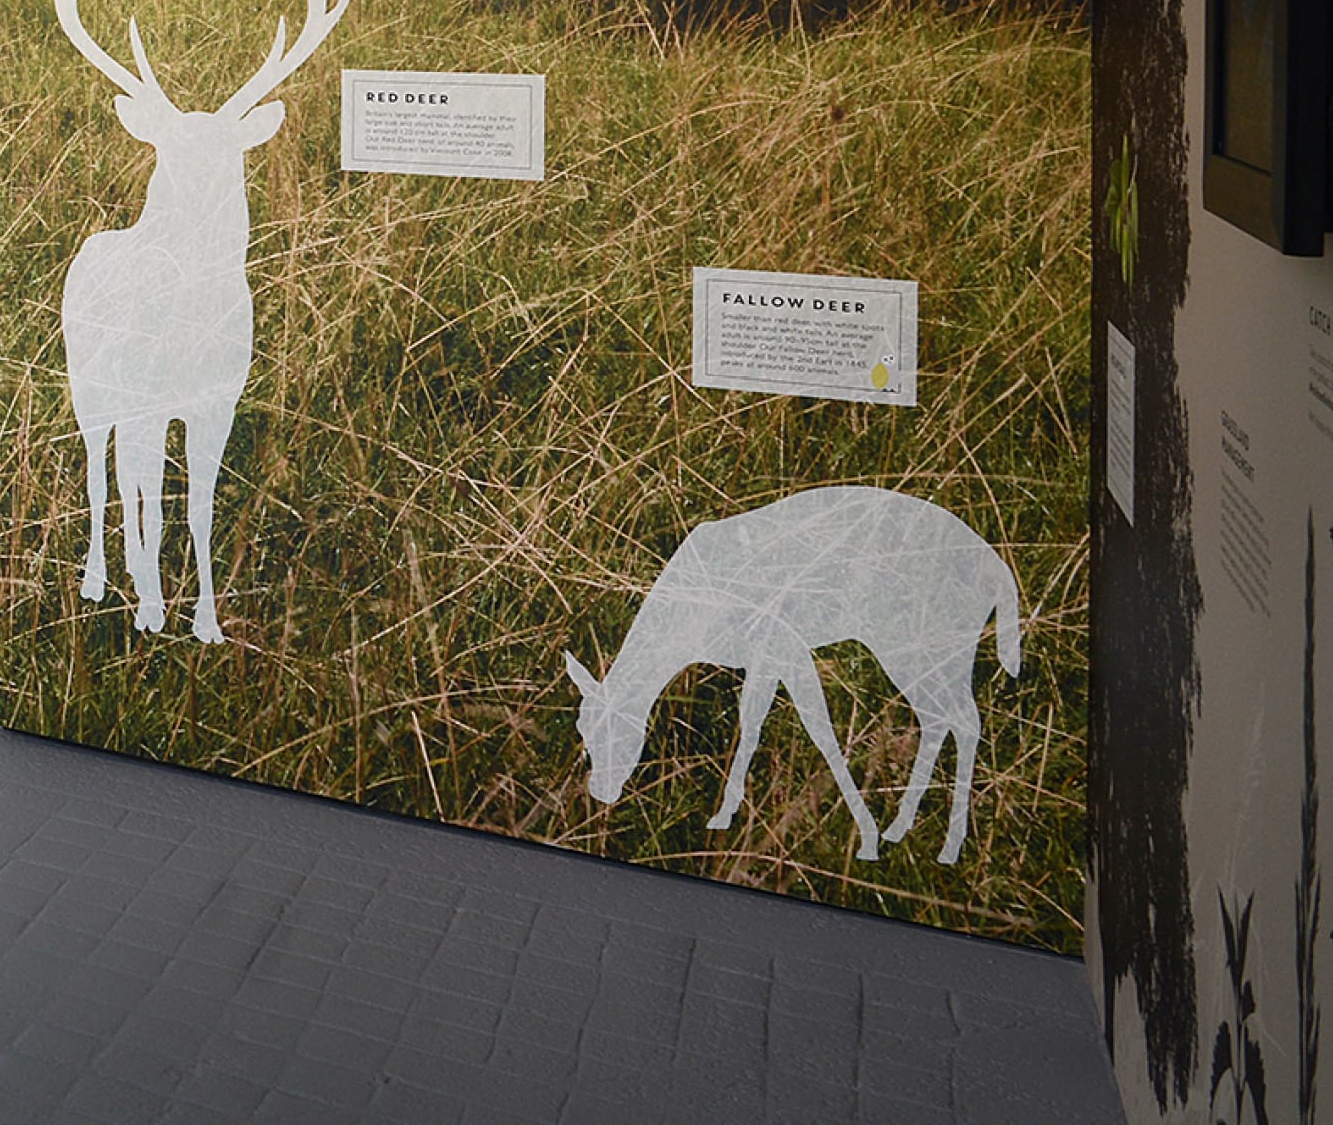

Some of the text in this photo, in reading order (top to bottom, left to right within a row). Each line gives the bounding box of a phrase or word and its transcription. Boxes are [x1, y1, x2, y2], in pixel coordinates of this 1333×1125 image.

[366, 91, 449, 105] RED DEER
[723, 293, 865, 314] FALLOW DEER
